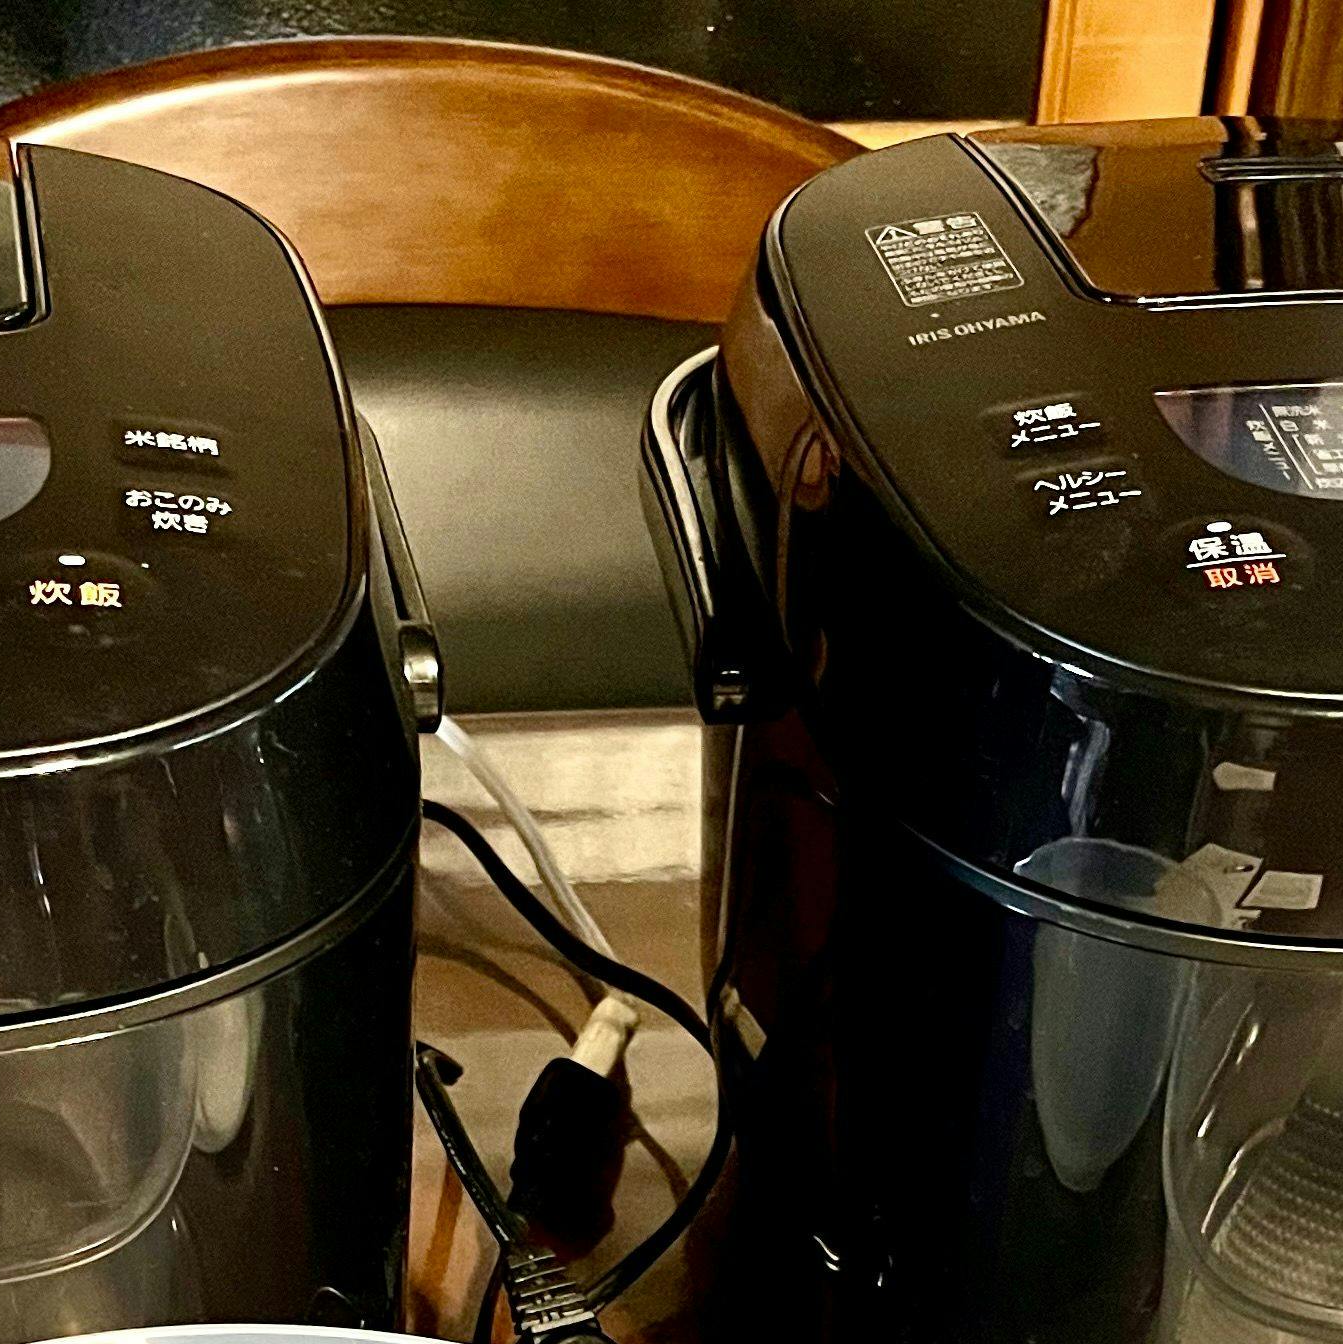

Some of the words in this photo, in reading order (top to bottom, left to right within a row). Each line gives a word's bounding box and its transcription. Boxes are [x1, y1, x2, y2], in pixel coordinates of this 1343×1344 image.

[908, 328, 952, 346] IRIS
[954, 311, 1047, 336] OHYAMA
[124, 430, 219, 457] 米銘柄
[1011, 422, 1101, 448] メニュー
[1034, 470, 1127, 492] ヘルシー
[125, 489, 232, 517] おこのみ
[1049, 490, 1141, 515] メニュー
[151, 511, 209, 534] 炊き
[1189, 532, 1273, 561] 保温
[1203, 562, 1281, 589] 取消
[29, 580, 122, 609] 炊飯
